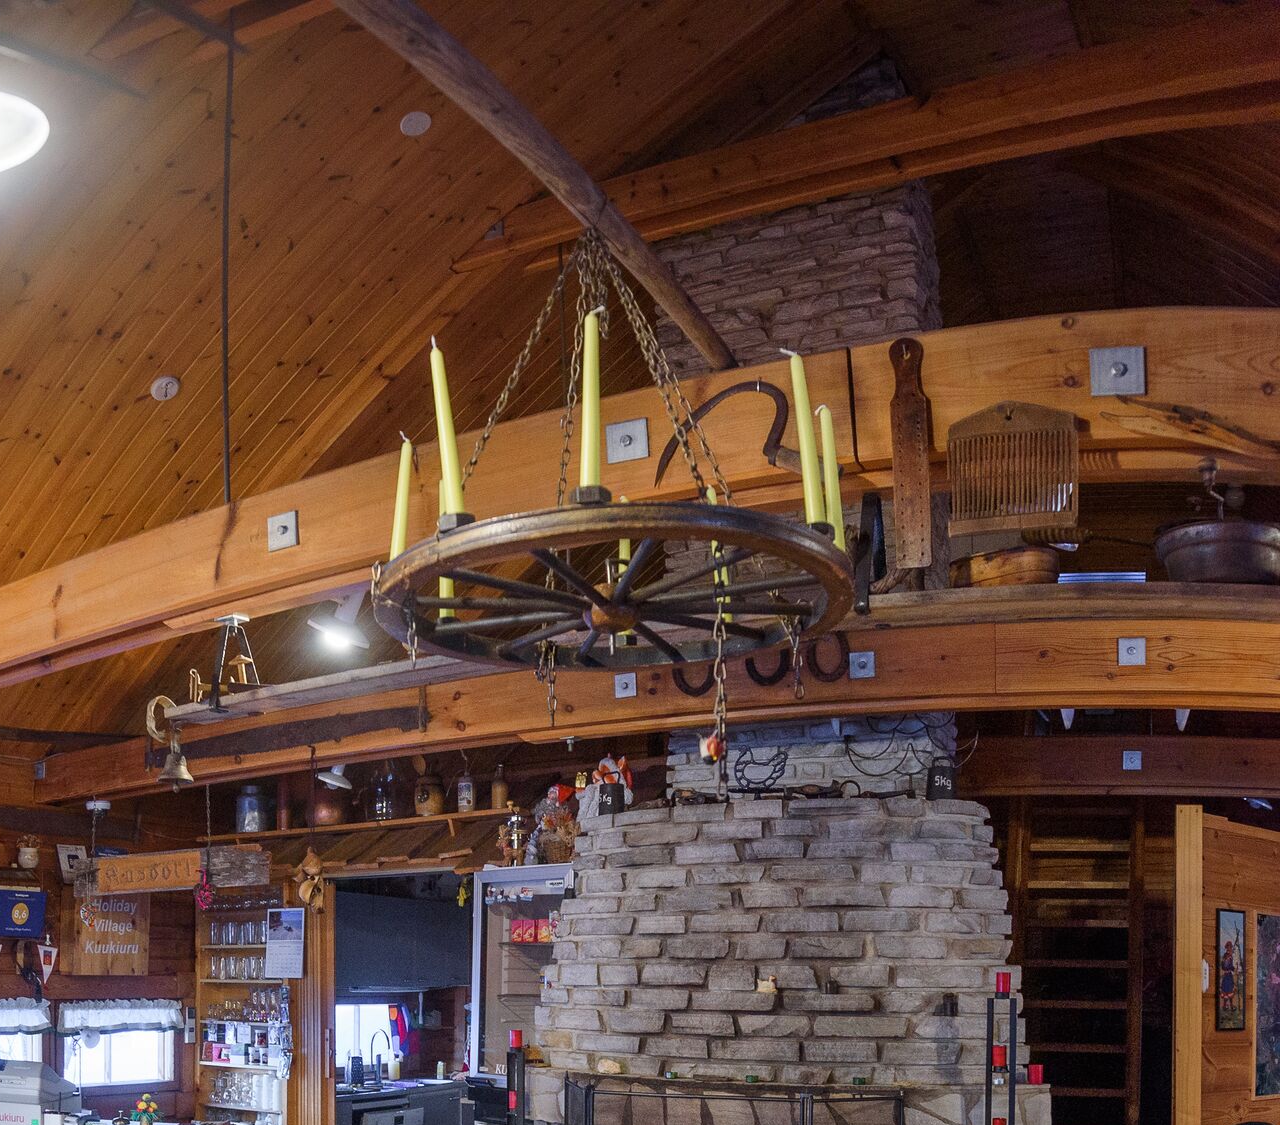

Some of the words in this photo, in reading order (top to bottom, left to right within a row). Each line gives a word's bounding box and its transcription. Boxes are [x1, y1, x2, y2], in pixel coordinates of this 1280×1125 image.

[934, 775, 952, 790] 5Kg
[13, 909, 28, 920] 8,6
[93, 899, 137, 915] Holiday
[93, 919, 134, 935] Village
[84, 940, 139, 955] Kuukiuru
